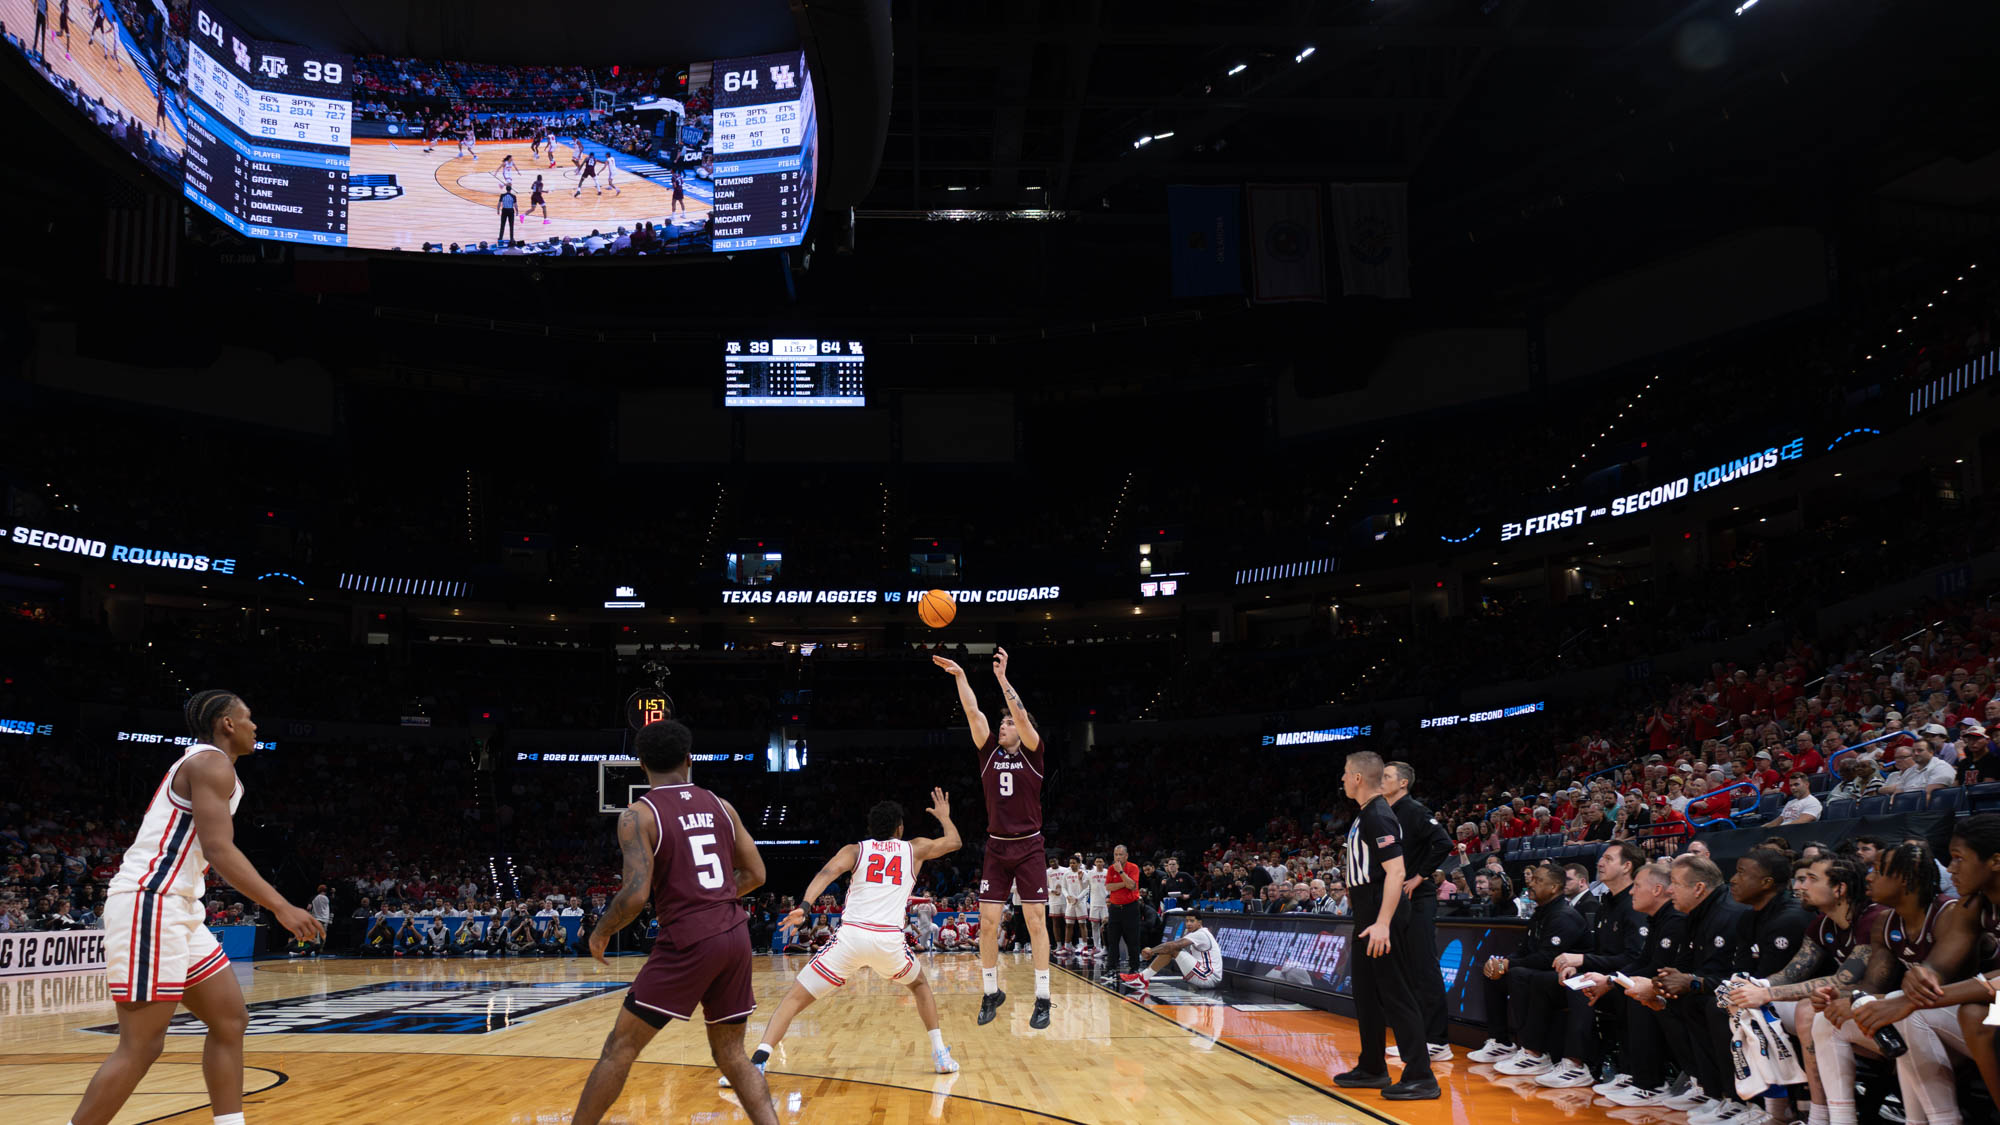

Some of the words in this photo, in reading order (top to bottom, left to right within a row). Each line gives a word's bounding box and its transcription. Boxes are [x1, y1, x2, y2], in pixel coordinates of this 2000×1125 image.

[198, 10, 224, 48] 64
[303, 60, 342, 84] 39
[724, 69, 759, 92] 64
[260, 95, 279, 103] FG%
[291, 99, 315, 108] 3PT%
[328, 103, 345, 111] FT%
[259, 102, 280, 113] 35.1
[325, 111, 346, 121] 72.7
[720, 111, 736, 119] FG%
[746, 108, 768, 117] 3PT%
[778, 104, 794, 112] FT%
[260, 117, 278, 126] REB
[293, 121, 310, 130] AST
[330, 125, 340, 133] TO
[719, 119, 737, 128] 45.1
[745, 116, 766, 126] 25.0
[775, 112, 796, 122] 92.3
[261, 126, 276, 135] 20
[720, 133, 736, 141] REB
[749, 130, 763, 138] AST
[781, 127, 790, 135] TO
[722, 141, 734, 150] 32
[751, 138, 762, 147] 10
[782, 135, 789, 144] 6
[253, 150, 280, 160] PLAYER
[325, 158, 338, 166] PTS
[338, 159, 350, 167] FLS
[186, 158, 213, 182] MCCARTY
[252, 162, 272, 172] HILL
[328, 171, 335, 179] 0
[341, 172, 347, 180] 0
[715, 165, 739, 174] PLAYER
[185, 172, 207, 192] MILLER
[251, 175, 289, 187] GRIFFEN
[328, 184, 334, 192] 4
[340, 185, 347, 193] 2
[715, 176, 754, 186] FLEMINGS
[781, 173, 787, 181] 9
[251, 188, 273, 198] LANE
[714, 190, 735, 199] UZAN
[779, 185, 789, 193] 12
[792, 184, 797, 192] 1
[250, 201, 303, 214] DOMINGUEZ
[340, 210, 346, 218] 3
[714, 202, 744, 211] TUGLER
[781, 198, 787, 206] 2
[792, 197, 798, 205] 1
[250, 214, 272, 224] AGEE
[327, 222, 333, 230] 7
[339, 223, 346, 231] 2
[714, 214, 752, 224] MCCARTY
[251, 227, 269, 236] 2ND
[273, 230, 299, 239] 11:57
[312, 234, 328, 242] TOL
[714, 227, 744, 236] MILLER
[792, 222, 798, 230] 1
[715, 241, 732, 249] 2ND
[735, 239, 757, 248] 11:57
[768, 237, 784, 245] TOL
[749, 341, 769, 353] 39
[784, 345, 806, 353] 11:57
[821, 341, 841, 353] 64
[1525, 506, 1587, 536] FIRST
[1590, 507, 1606, 518] AND
[1610, 477, 1689, 517] SECOND
[1693, 447, 1778, 492] ROUNDS
[12, 526, 107, 558] SECOND
[111, 544, 210, 571] ROUNDS
[721, 590, 773, 603] TEXAS
[775, 590, 813, 603] A&M
[815, 590, 877, 603] AGGIES
[884, 591, 901, 602] VS
[906, 590, 982, 603] HOTON
[985, 586, 1060, 603] COUGARS
[637, 699, 666, 710] 11:57
[1431, 715, 1460, 727] FIRST
[1469, 709, 1503, 723] SECOND
[1503, 703, 1536, 718] ROUNDS
[130, 732, 164, 743] FIRST
[580, 754, 608, 762] MEN'S
[1000, 771, 1013, 796] 9
[678, 813, 714, 831] LANE
[688, 833, 725, 890] 5
[866, 853, 903, 886] 24
[18, 937, 38, 968] 12
